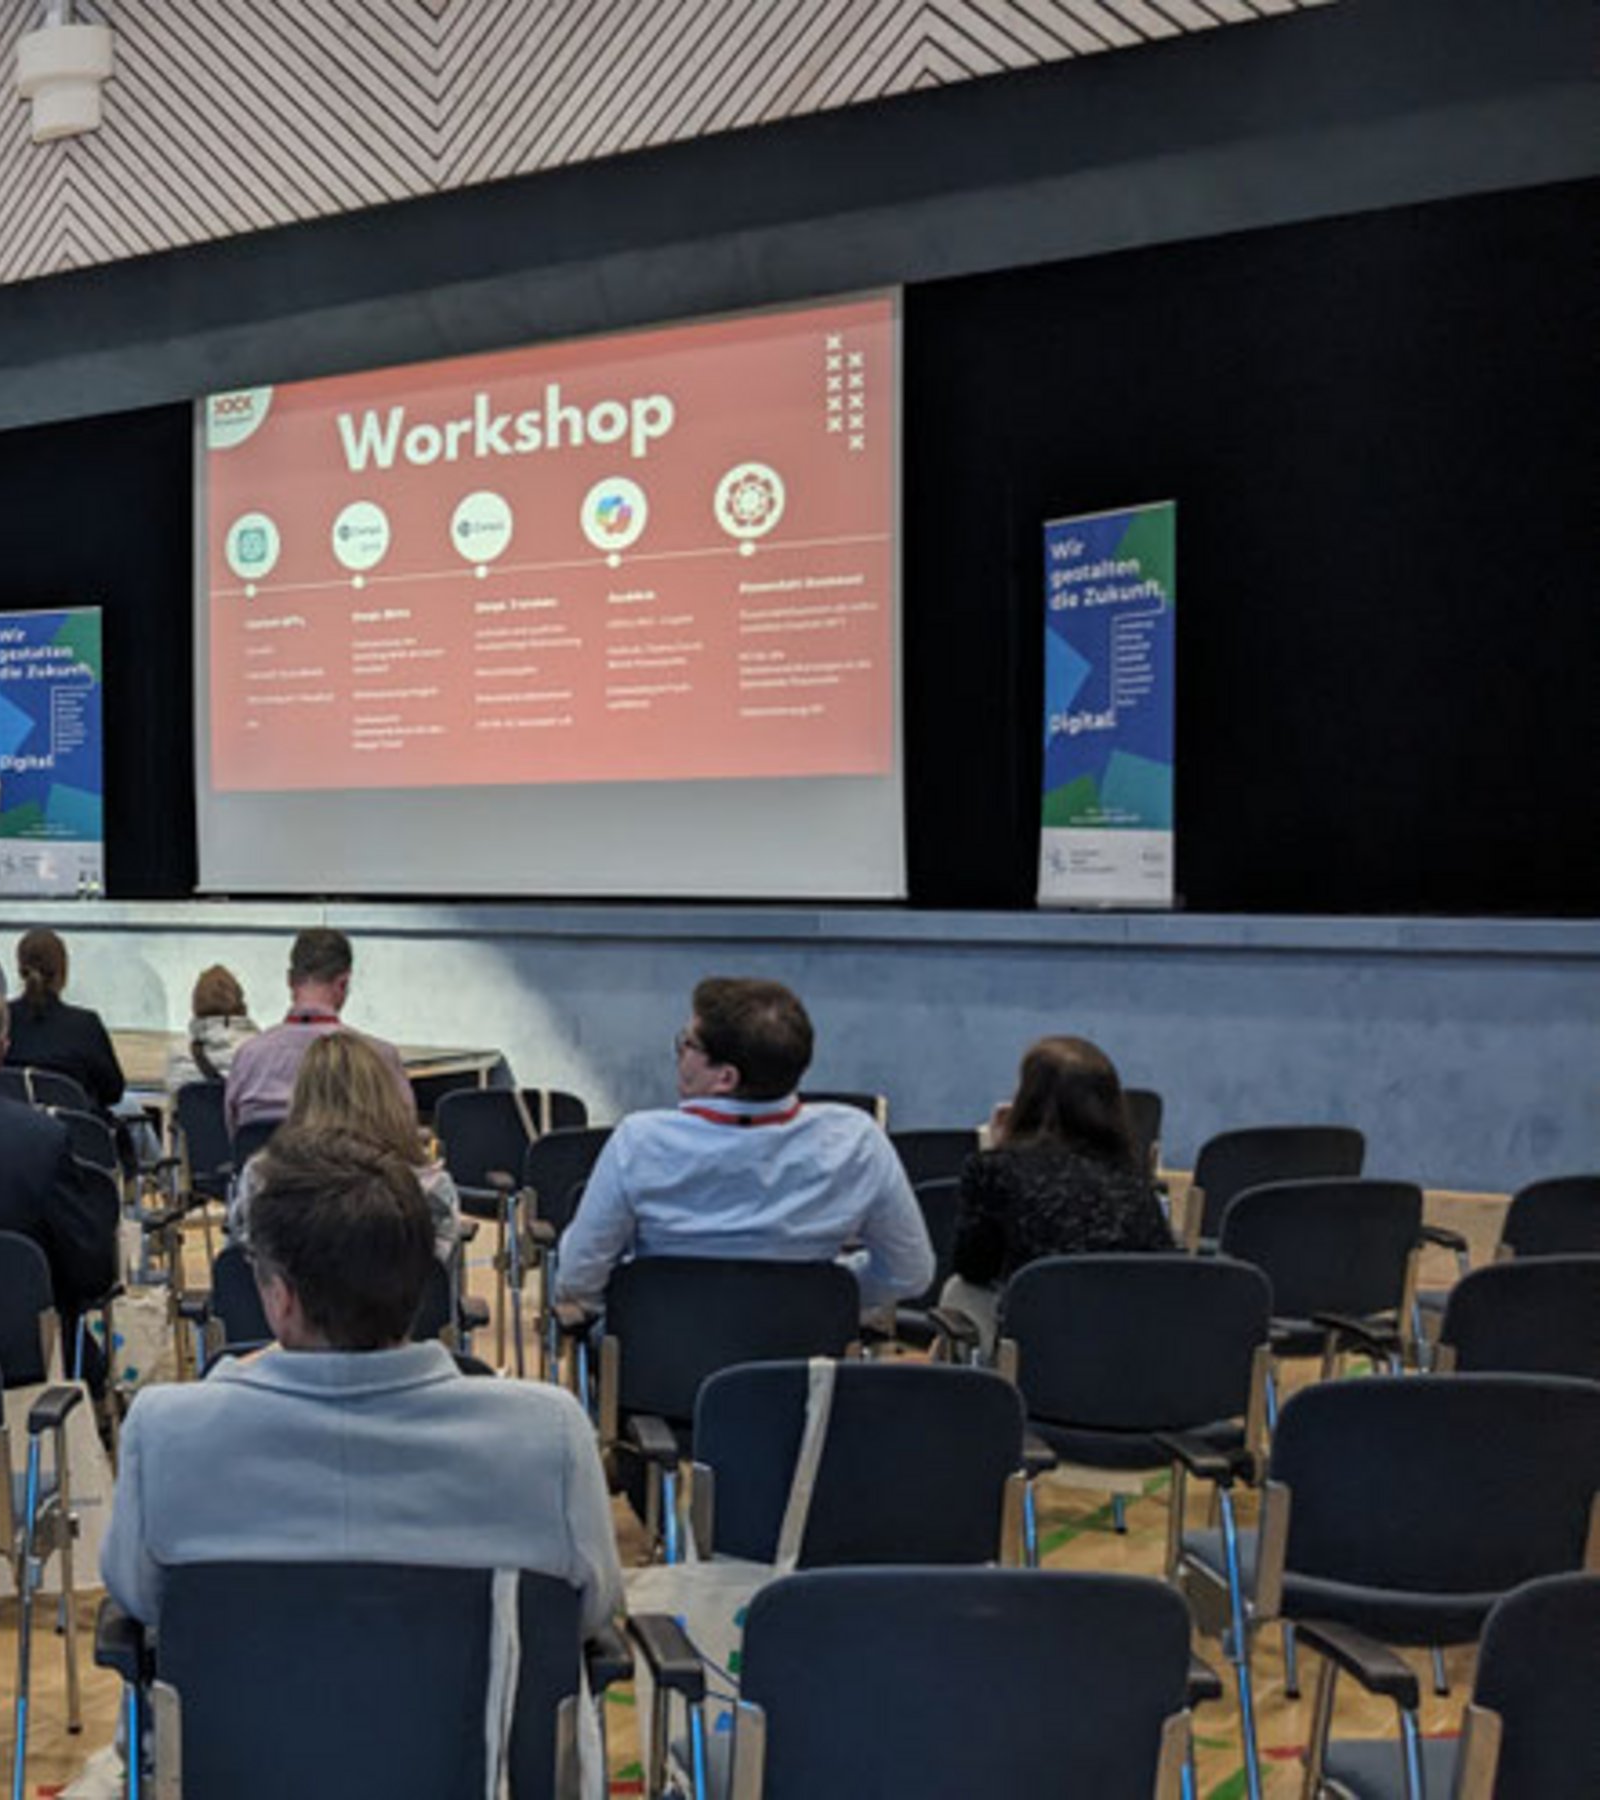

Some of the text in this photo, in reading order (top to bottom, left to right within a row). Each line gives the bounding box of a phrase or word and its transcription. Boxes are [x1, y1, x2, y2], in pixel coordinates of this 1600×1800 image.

[338, 384, 674, 471] Workshop
[1051, 540, 1085, 559] Wir
[1051, 559, 1140, 589] gestalten
[1051, 591, 1079, 610] die
